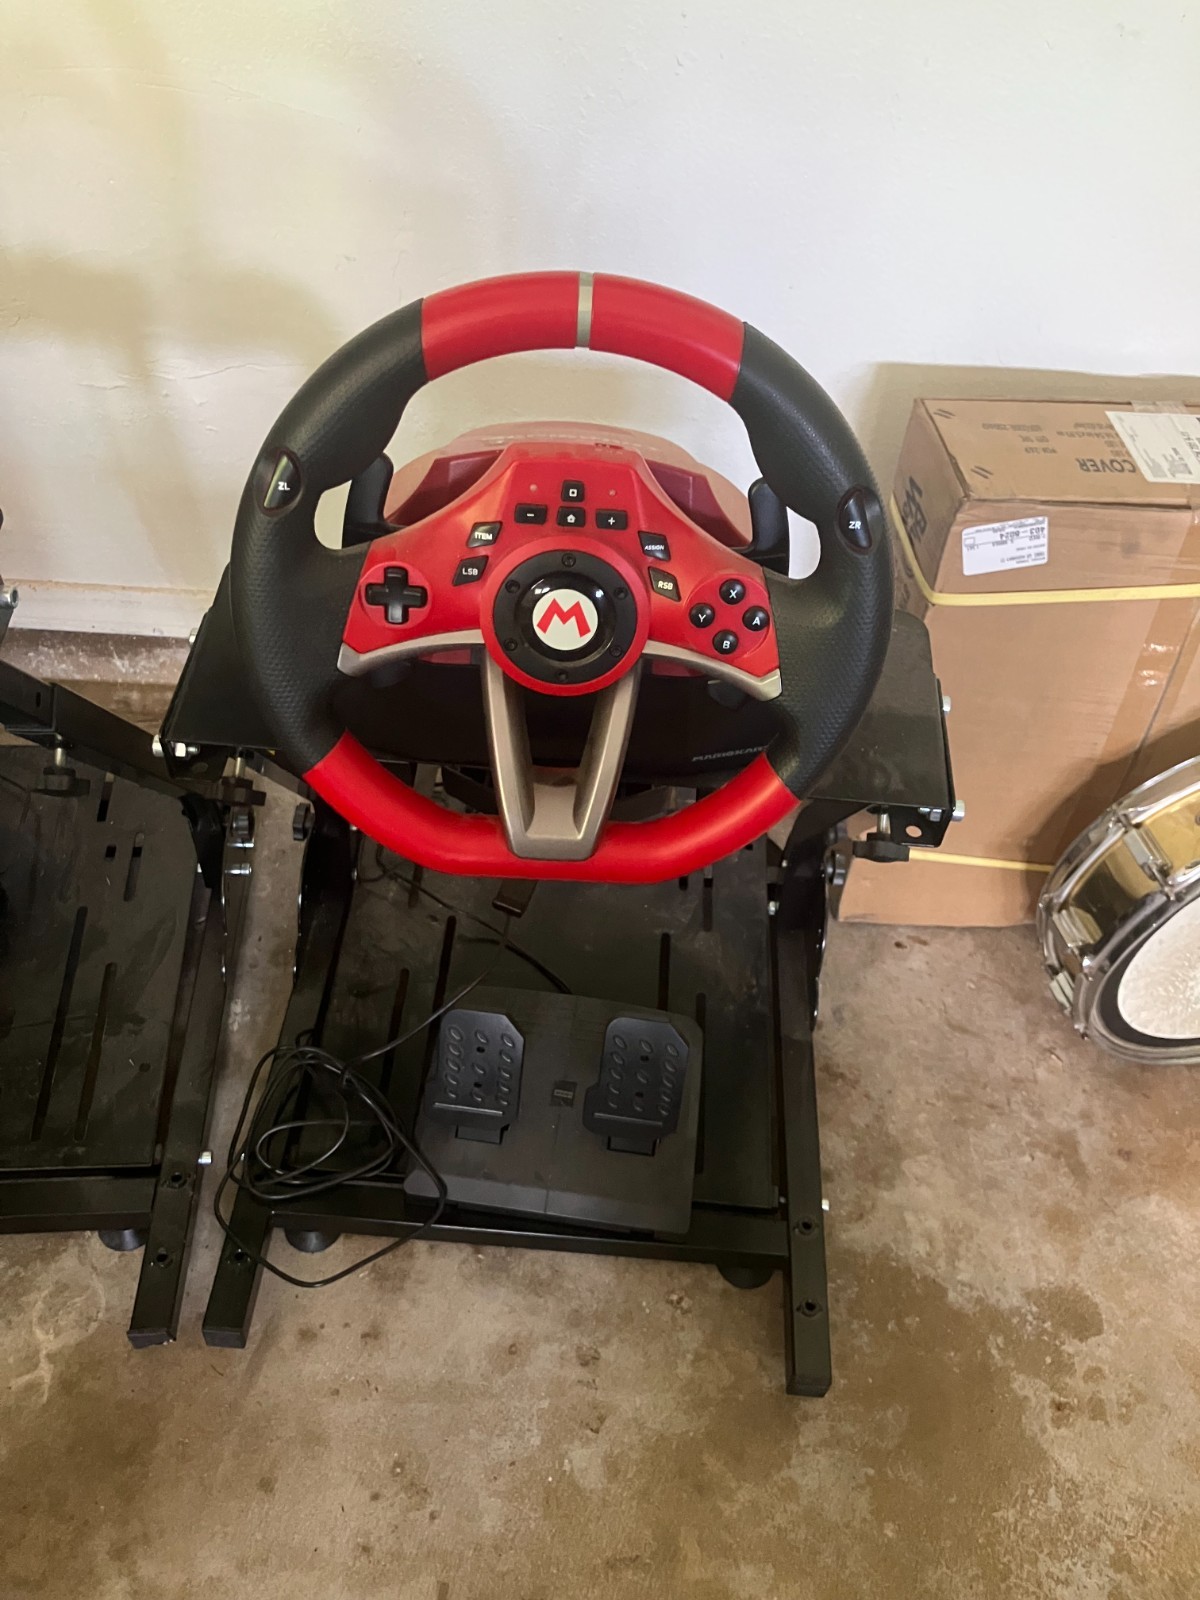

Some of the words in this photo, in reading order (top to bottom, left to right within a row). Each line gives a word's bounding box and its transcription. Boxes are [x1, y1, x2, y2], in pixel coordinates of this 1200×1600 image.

[1075, 458, 1136, 473] COVER
[278, 481, 290, 490] ZL
[848, 520, 861, 530] ZR
[474, 531, 493, 540] ITEM
[462, 567, 479, 576] LSB
[657, 580, 674, 591] RSB
[729, 589, 738, 599] X
[536, 598, 591, 638] M
[698, 613, 707, 623] Y
[751, 616, 760, 626] A
[722, 640, 731, 650] B
[692, 745, 769, 762] MARIOKAR
